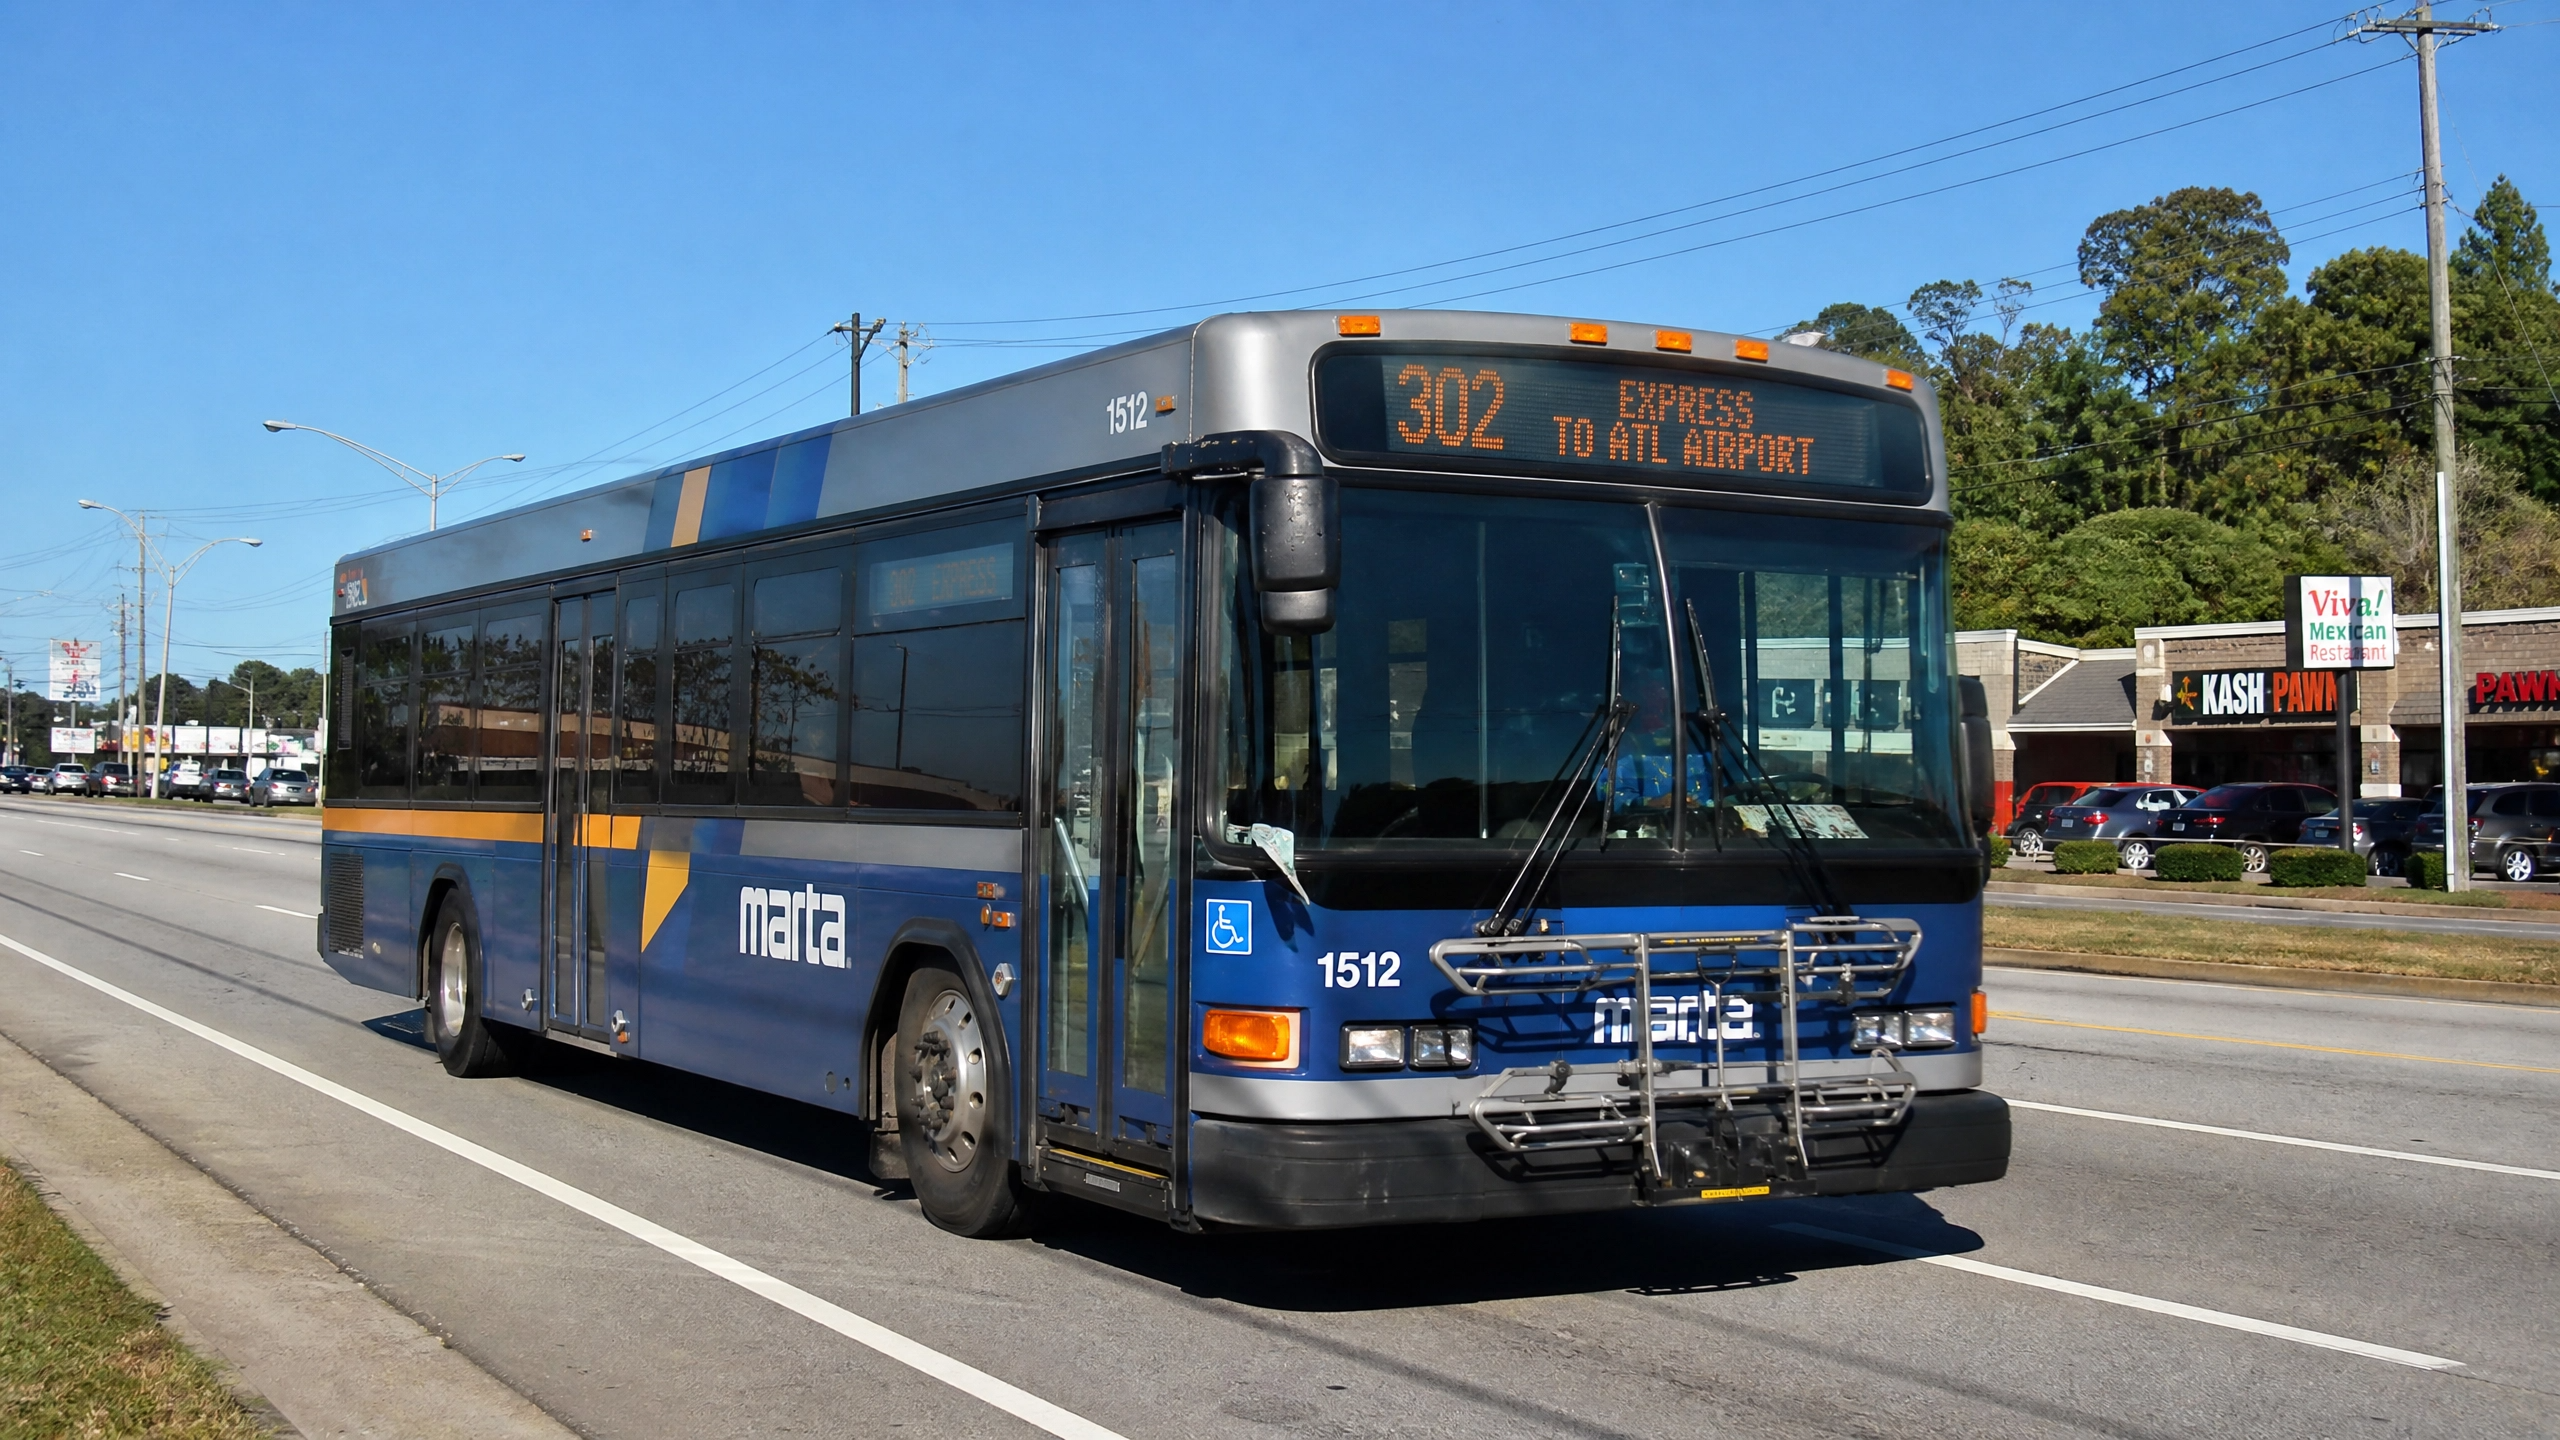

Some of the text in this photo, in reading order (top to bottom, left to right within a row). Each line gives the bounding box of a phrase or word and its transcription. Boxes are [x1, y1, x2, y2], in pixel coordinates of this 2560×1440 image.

[1106, 391, 1148, 435] 1512
[1398, 363, 1504, 450] 302
[1620, 379, 1753, 429] EXPRESS
[1553, 416, 1815, 475] TO ATL AIRPORT
[2308, 590, 2384, 616] Viva!
[2310, 622, 2386, 641] Mexican
[2202, 672, 2264, 715] KASH
[740, 884, 846, 969] marta
[1317, 951, 1400, 989] 1512
[1594, 990, 1753, 1044] marta
